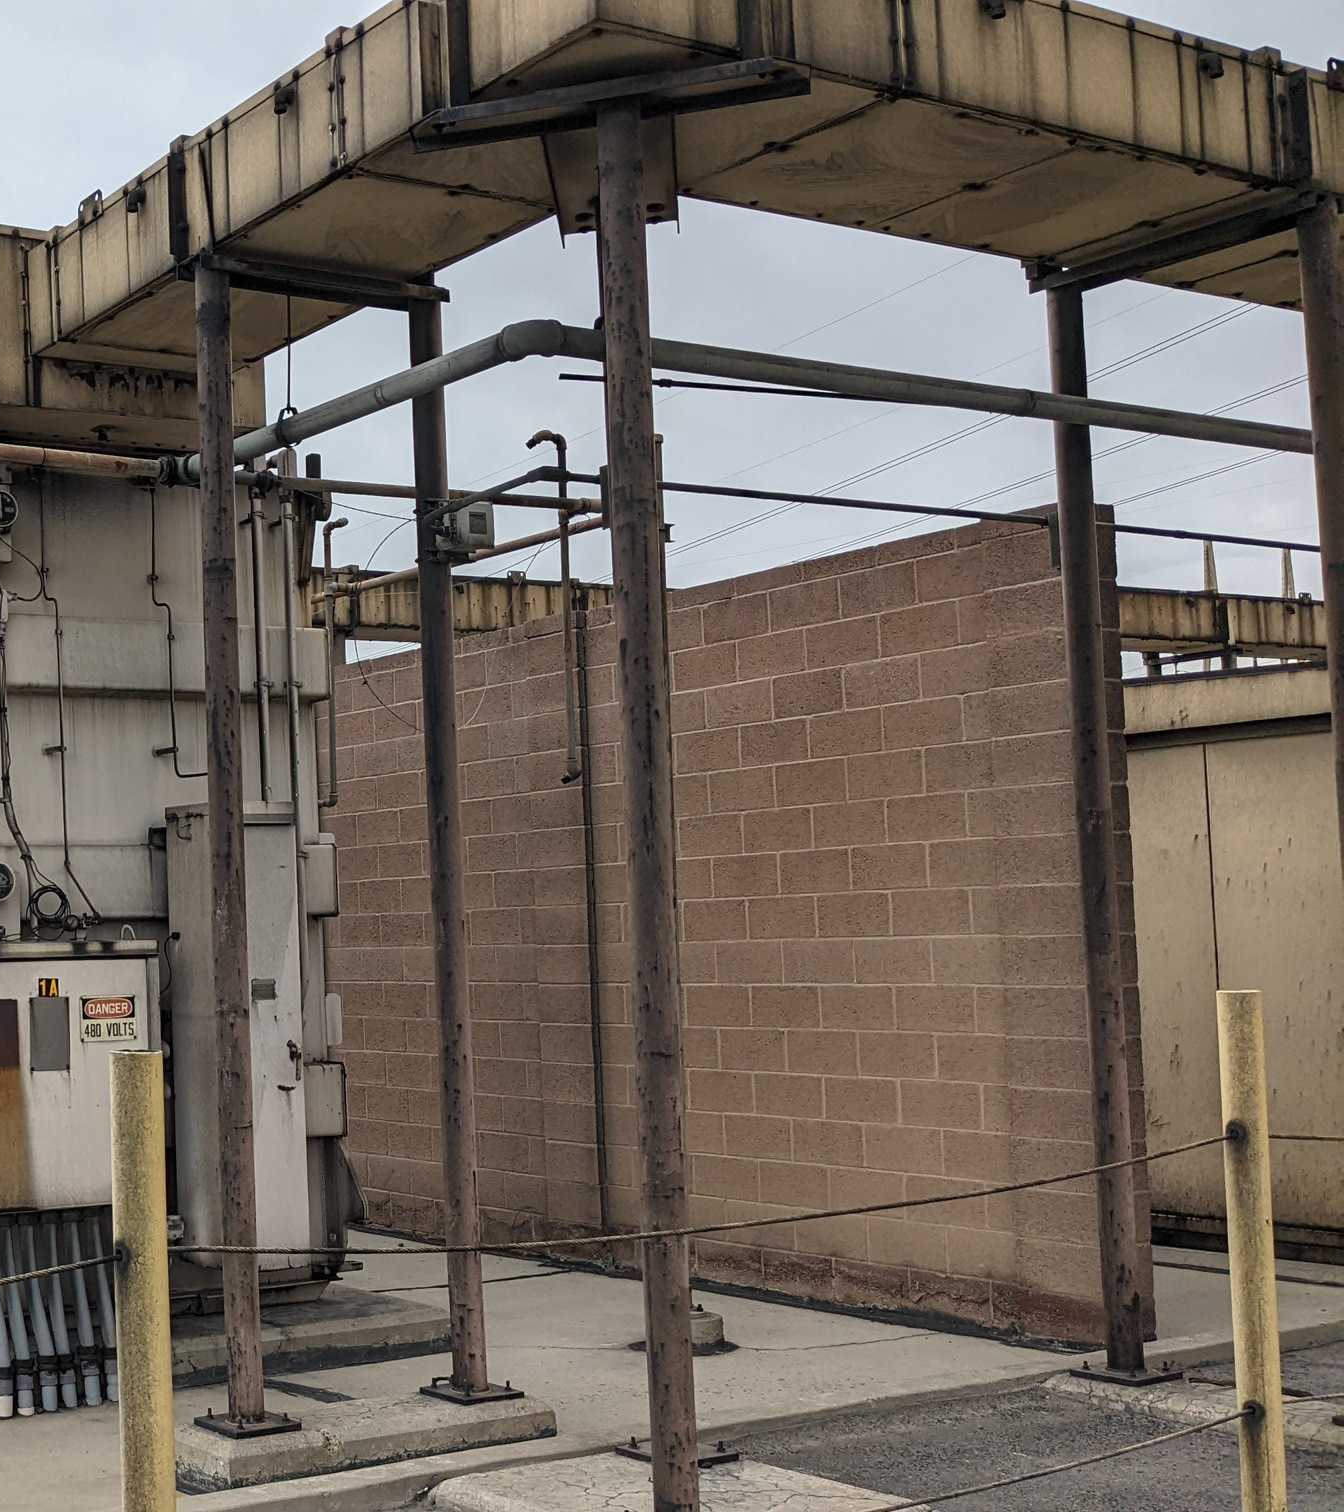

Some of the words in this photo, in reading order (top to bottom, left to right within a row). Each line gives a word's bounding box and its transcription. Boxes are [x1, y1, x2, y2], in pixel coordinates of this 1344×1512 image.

[39, 979, 58, 996] 1A
[87, 1002, 128, 1014] DANGER
[84, 1023, 102, 1037] 480
[106, 1022, 134, 1037] VOLTS
